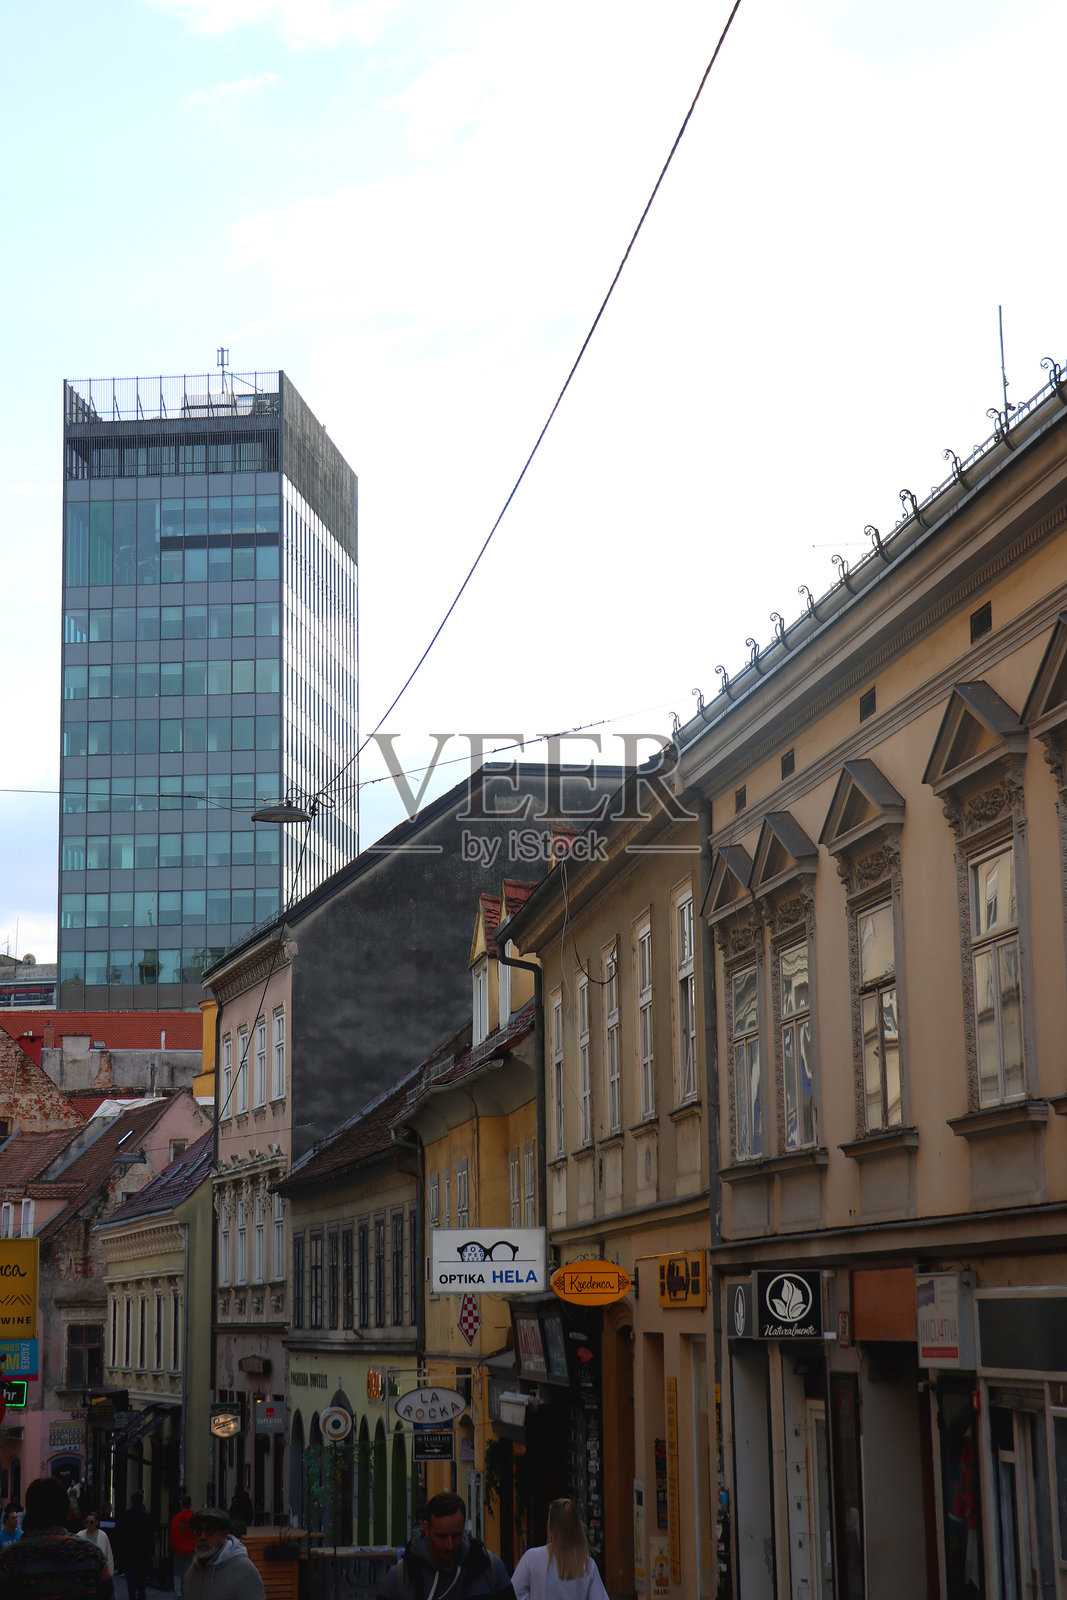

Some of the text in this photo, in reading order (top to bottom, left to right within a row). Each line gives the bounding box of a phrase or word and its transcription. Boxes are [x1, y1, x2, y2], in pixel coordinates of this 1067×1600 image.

[438, 1269, 538, 1285] OPTIKA HELA
[569, 1274, 615, 1293] Kredenca
[1, 1316, 32, 1325] WINE
[763, 1322, 818, 1337] Naturalmente
[20, 1342, 31, 1370] ZAGREB
[420, 1391, 440, 1404] LA
[402, 1401, 461, 1419] ROCKA
